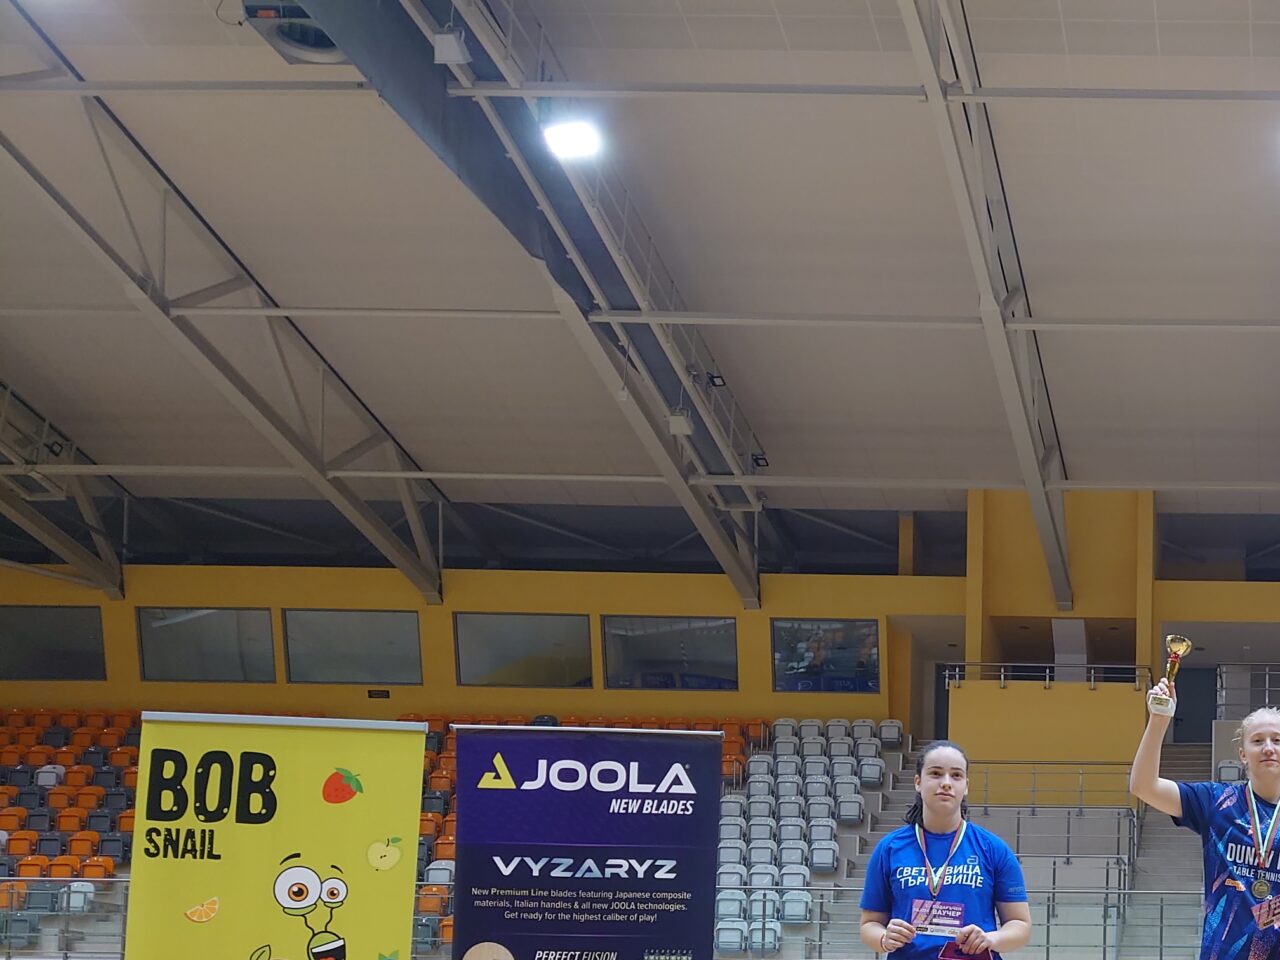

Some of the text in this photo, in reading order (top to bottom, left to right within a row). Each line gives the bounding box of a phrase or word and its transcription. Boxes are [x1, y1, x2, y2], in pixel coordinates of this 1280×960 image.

[520, 759, 696, 794] JOOLA
[146, 748, 277, 824] BOB
[609, 799, 694, 815] NEW BLADES
[144, 828, 221, 860] SNAIL
[492, 856, 678, 879] VYZARYZ
[1233, 865, 1255, 878] TABLE
[491, 888, 528, 897] Premium
[531, 889, 549, 897] Line
[551, 890, 577, 898] blades
[579, 890, 612, 899] featuring
[615, 891, 650, 899] Japanese
[652, 891, 691, 900] composite
[474, 900, 512, 908] materials,
[515, 900, 538, 908] Italian
[582, 901, 590, 909] all
[637, 902, 688, 912] technologies.
[504, 911, 518, 919] Get
[520, 912, 542, 920] ready
[573, 912, 600, 921] highest
[603, 913, 627, 921] caliber
[639, 914, 657, 923] play!
